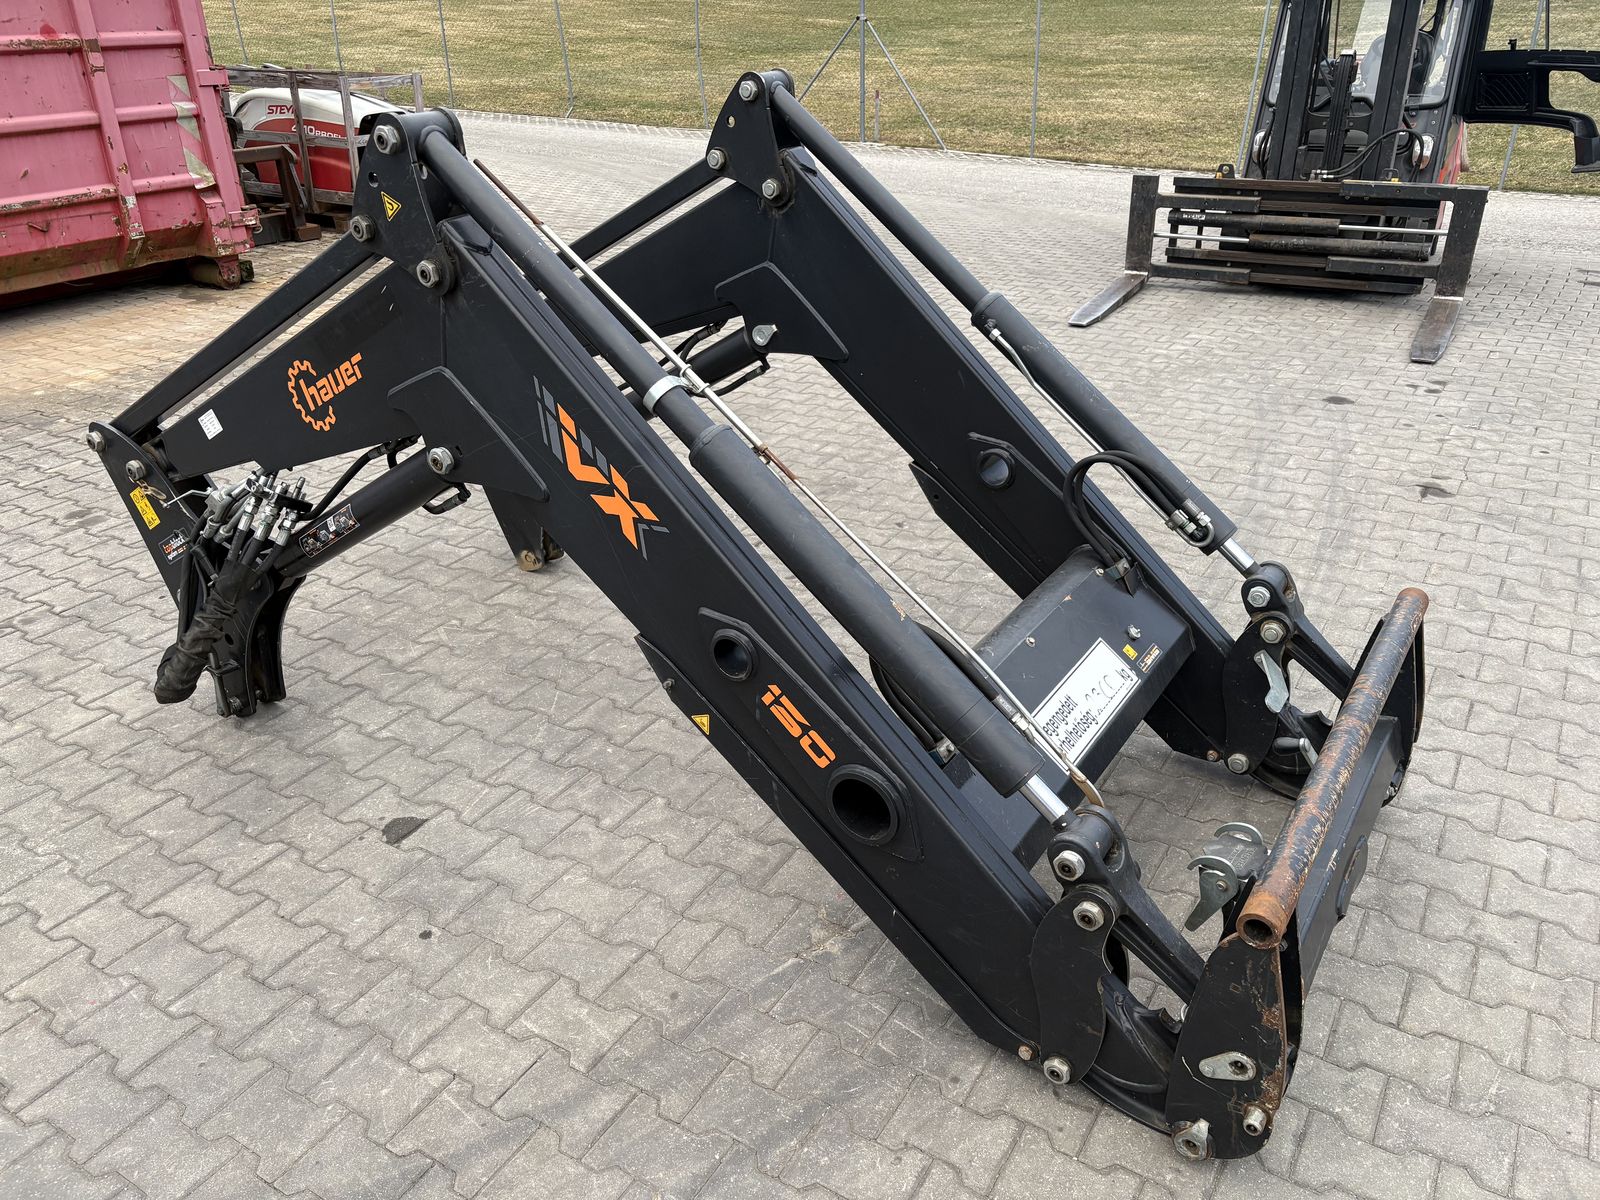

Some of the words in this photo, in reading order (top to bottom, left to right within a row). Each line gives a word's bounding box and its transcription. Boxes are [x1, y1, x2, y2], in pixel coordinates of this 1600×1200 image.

[267, 104, 297, 115] STEY
[298, 352, 362, 412] hauer
[760, 684, 836, 769] 150
[1041, 693, 1079, 738] egengedett
[1058, 708, 1100, 754] rhelhetőség:
[1115, 668, 1134, 682] kg
